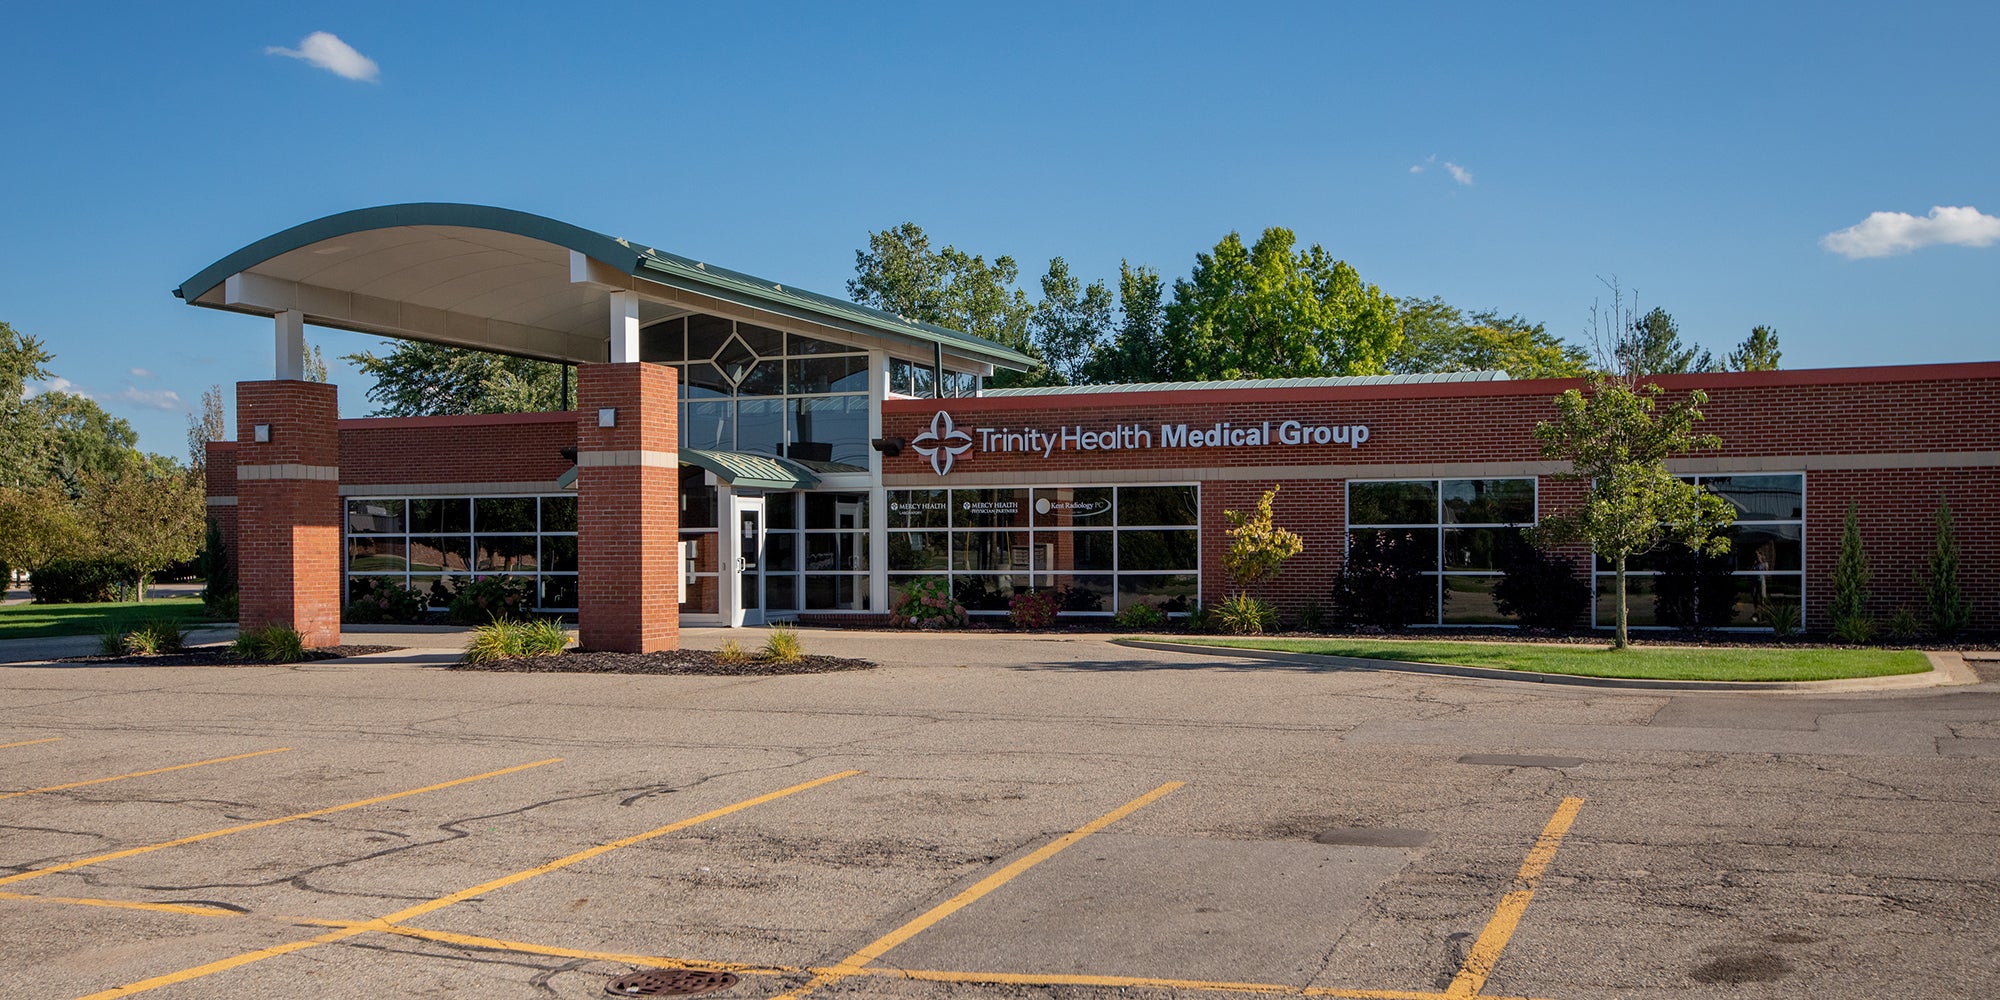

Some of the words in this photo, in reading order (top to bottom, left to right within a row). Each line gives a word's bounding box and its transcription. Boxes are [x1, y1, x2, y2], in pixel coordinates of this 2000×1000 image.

[976, 426, 1058, 459] Trinity
[1061, 423, 1152, 451] Health
[1161, 421, 1270, 448] Medical
[1278, 420, 1370, 449] Group
[1065, 502, 1094, 510] Radiology
